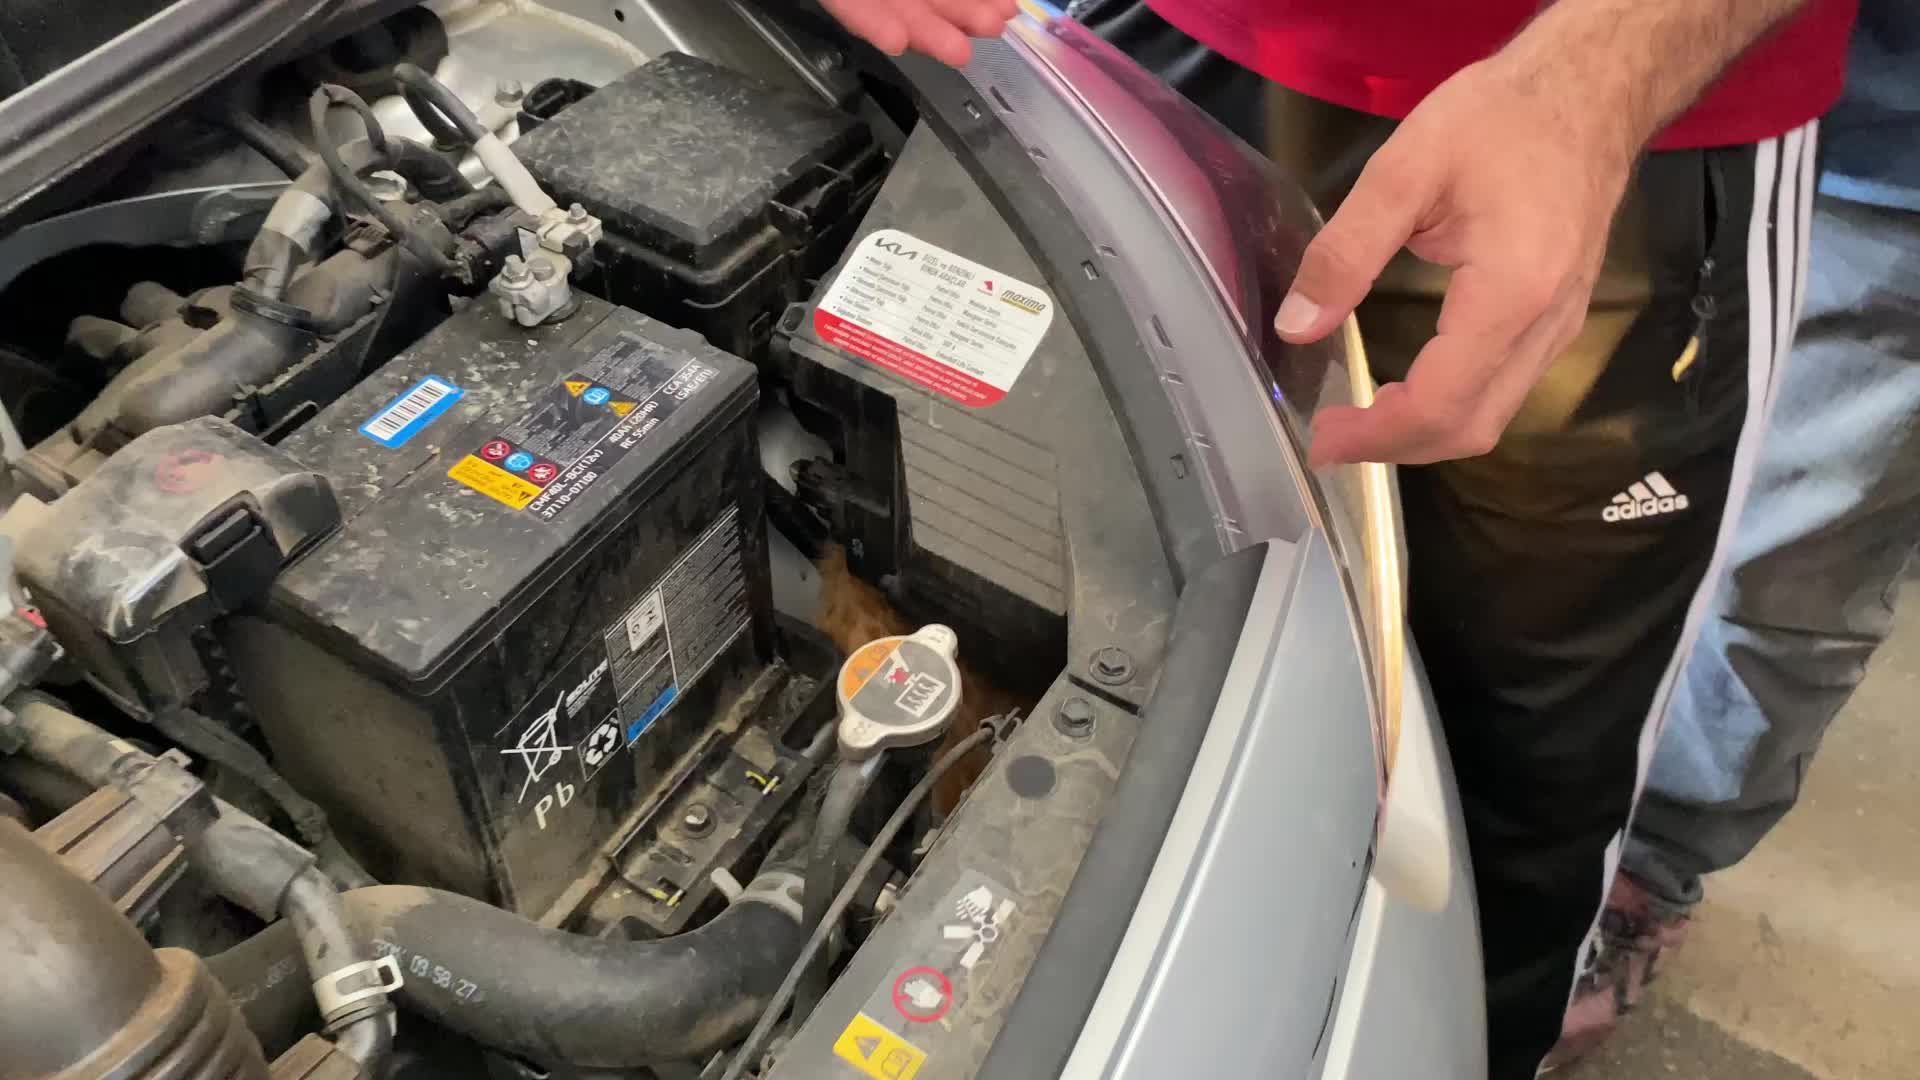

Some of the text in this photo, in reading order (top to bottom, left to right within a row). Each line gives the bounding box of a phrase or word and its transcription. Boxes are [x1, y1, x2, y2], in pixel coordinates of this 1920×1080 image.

[875, 237, 918, 261] KIA
[1001, 289, 1047, 313] maxima
[609, 424, 633, 443] 40Ah
[662, 379, 684, 395] CCA
[542, 470, 598, 520] 37110-07100
[619, 436, 638, 450] RC
[1602, 494, 1689, 522] adidas
[533, 781, 575, 830] Pb
